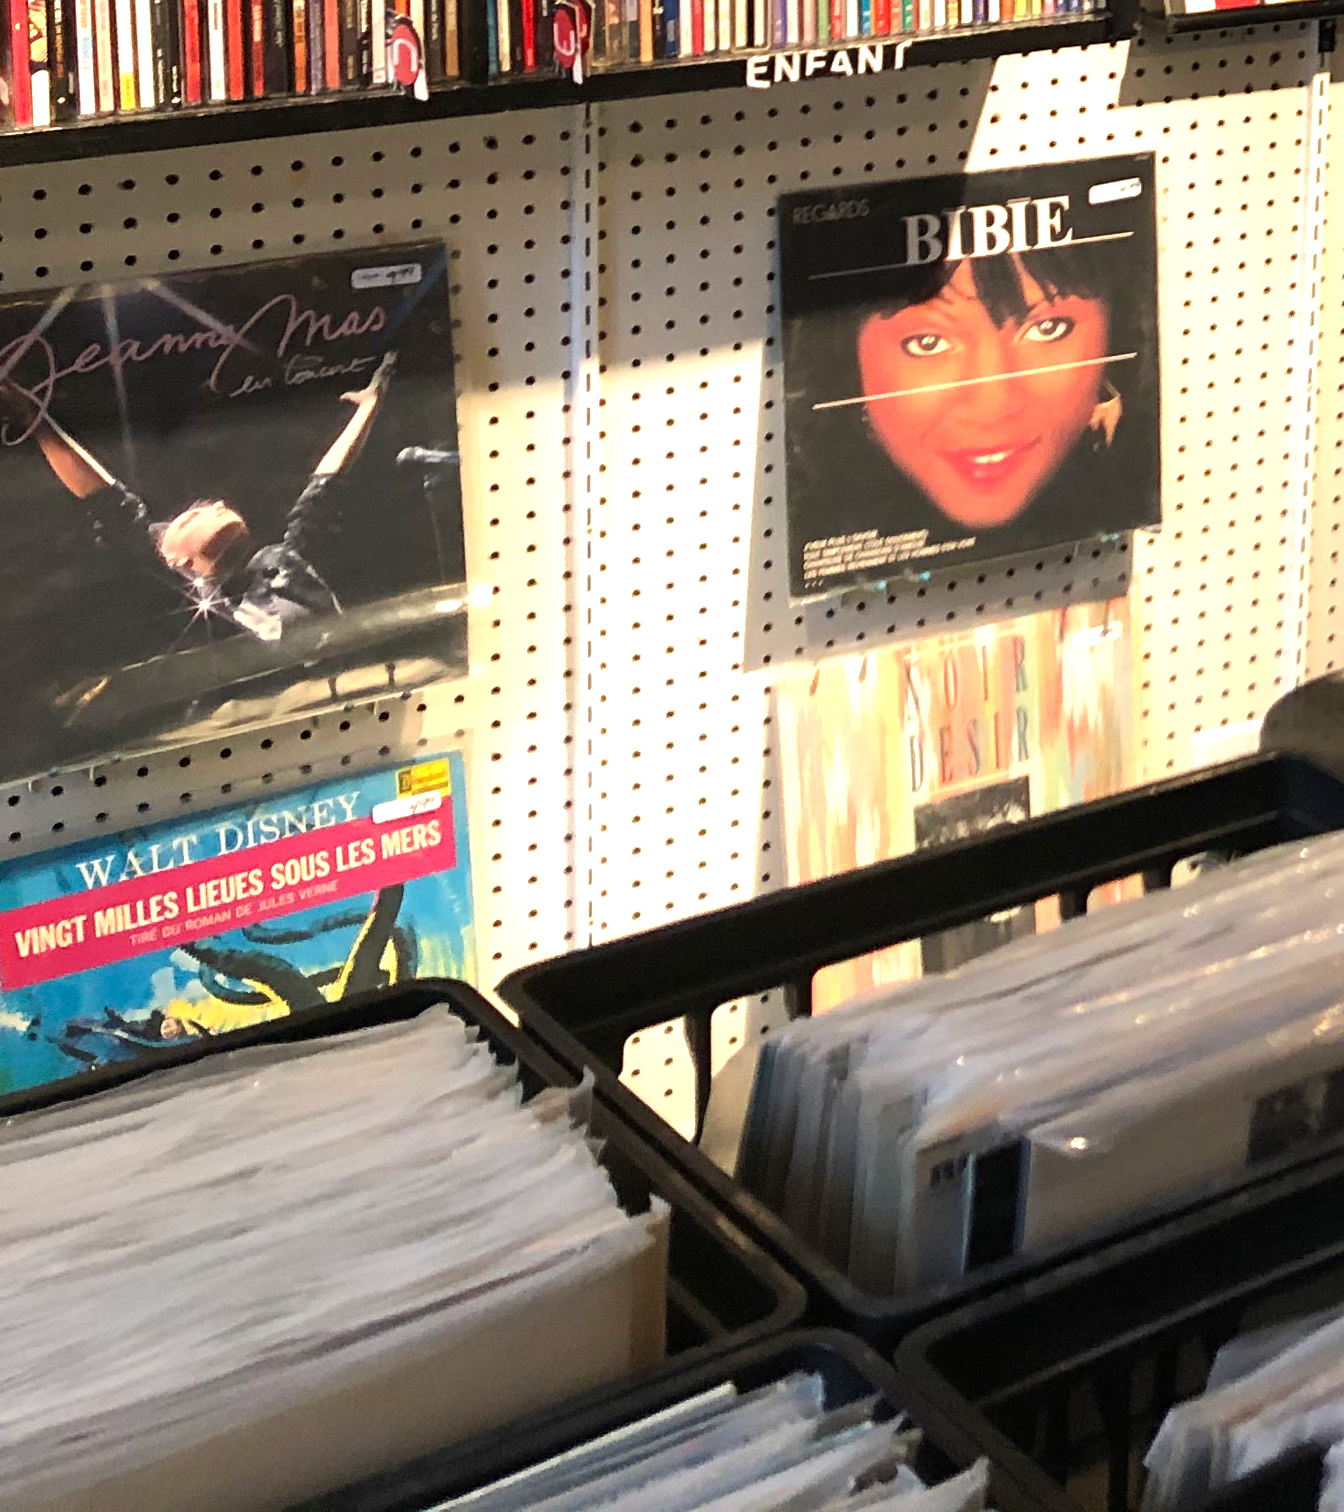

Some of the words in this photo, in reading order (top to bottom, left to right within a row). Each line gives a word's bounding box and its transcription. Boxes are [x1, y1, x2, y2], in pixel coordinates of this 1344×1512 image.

[746, 40, 914, 90] ENFANT
[791, 197, 870, 225] REGARDS
[901, 195, 1074, 266] BIBIE
[234, 294, 387, 394] Mas
[229, 373, 275, 398] en
[902, 633, 1030, 727] NOIR
[907, 704, 1032, 792] DESIR
[75, 831, 199, 891] WALT
[216, 791, 364, 857] DISNEY
[14, 912, 89, 959] VINGT
[93, 891, 181, 939] MILLES
[184, 869, 264, 914] LIEUES
[270, 850, 332, 890] SOUS
[334, 839, 377, 873] LES
[380, 820, 443, 861] MERS
[161, 921, 181, 940] DU
[184, 910, 233, 935] ROMAN
[235, 903, 254, 920] DE
[256, 892, 296, 915] JULES
[297, 879, 339, 906] VERNE
